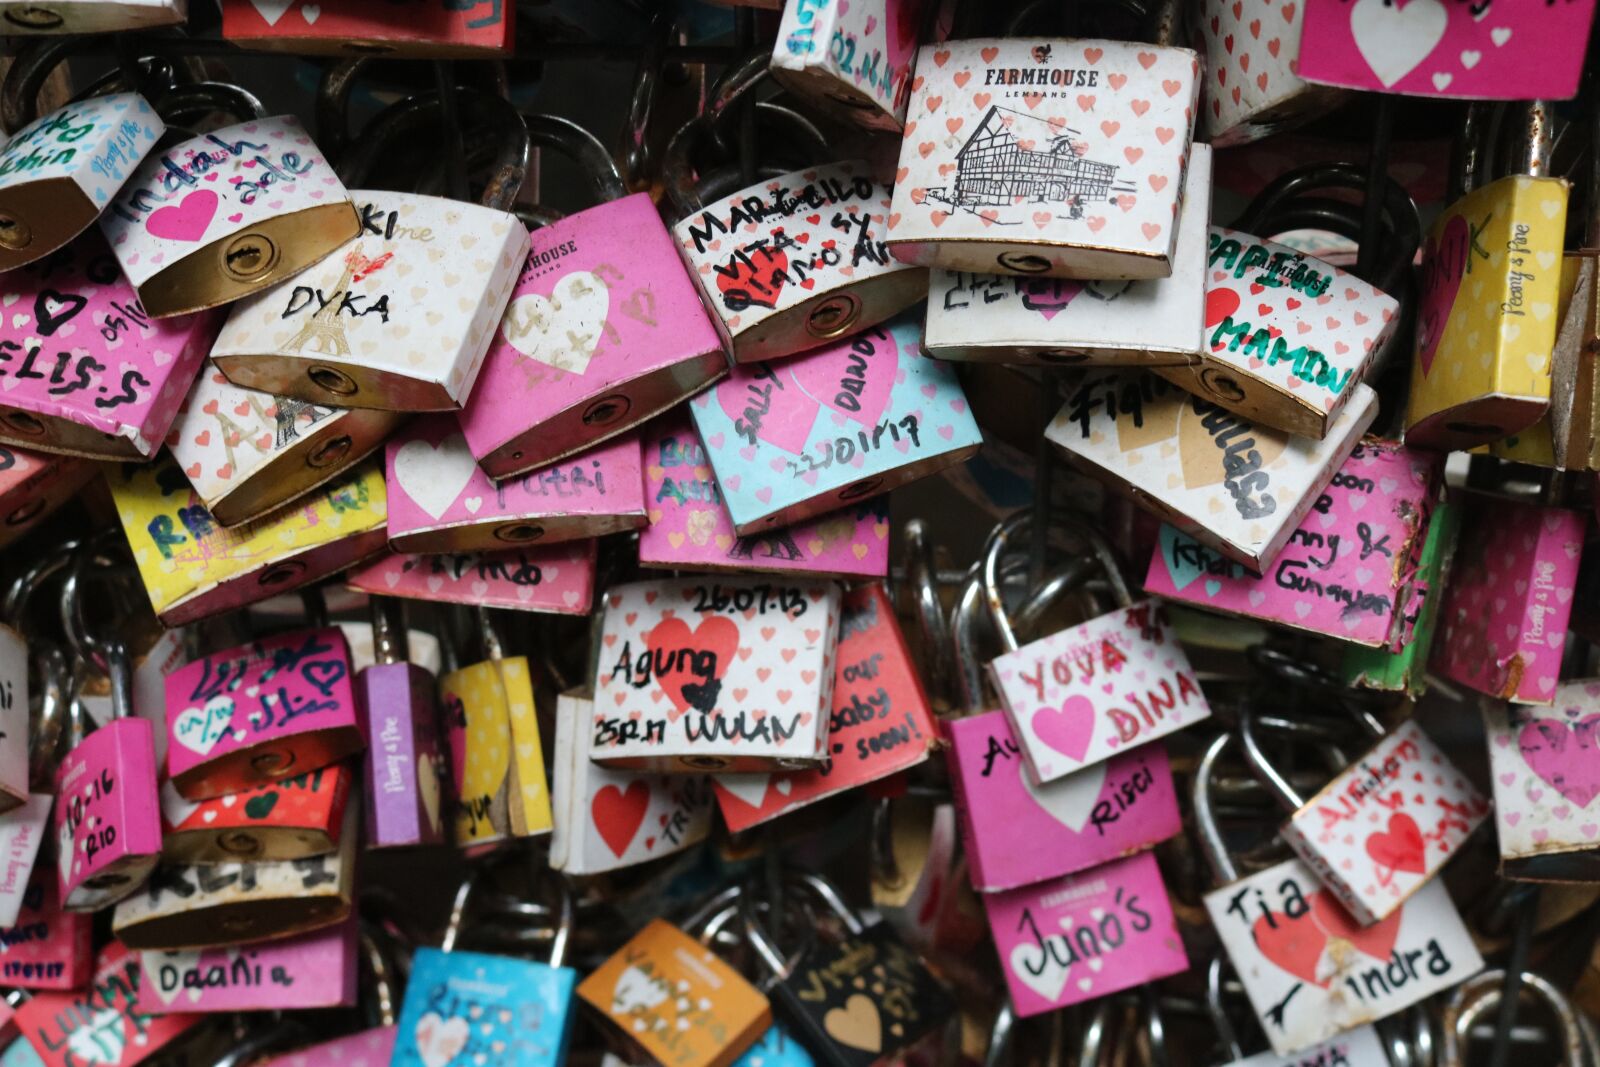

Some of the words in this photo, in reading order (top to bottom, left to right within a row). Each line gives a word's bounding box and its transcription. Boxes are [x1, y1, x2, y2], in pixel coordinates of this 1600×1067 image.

[984, 68, 1099, 87] FARMHOUSE
[1005, 90, 1068, 99] LEMBANG
[1506, 224, 1530, 255] Pine
[521, 240, 578, 274] MHOUSE
[1501, 271, 1535, 316] Peony
[1523, 603, 1557, 645] Peony
